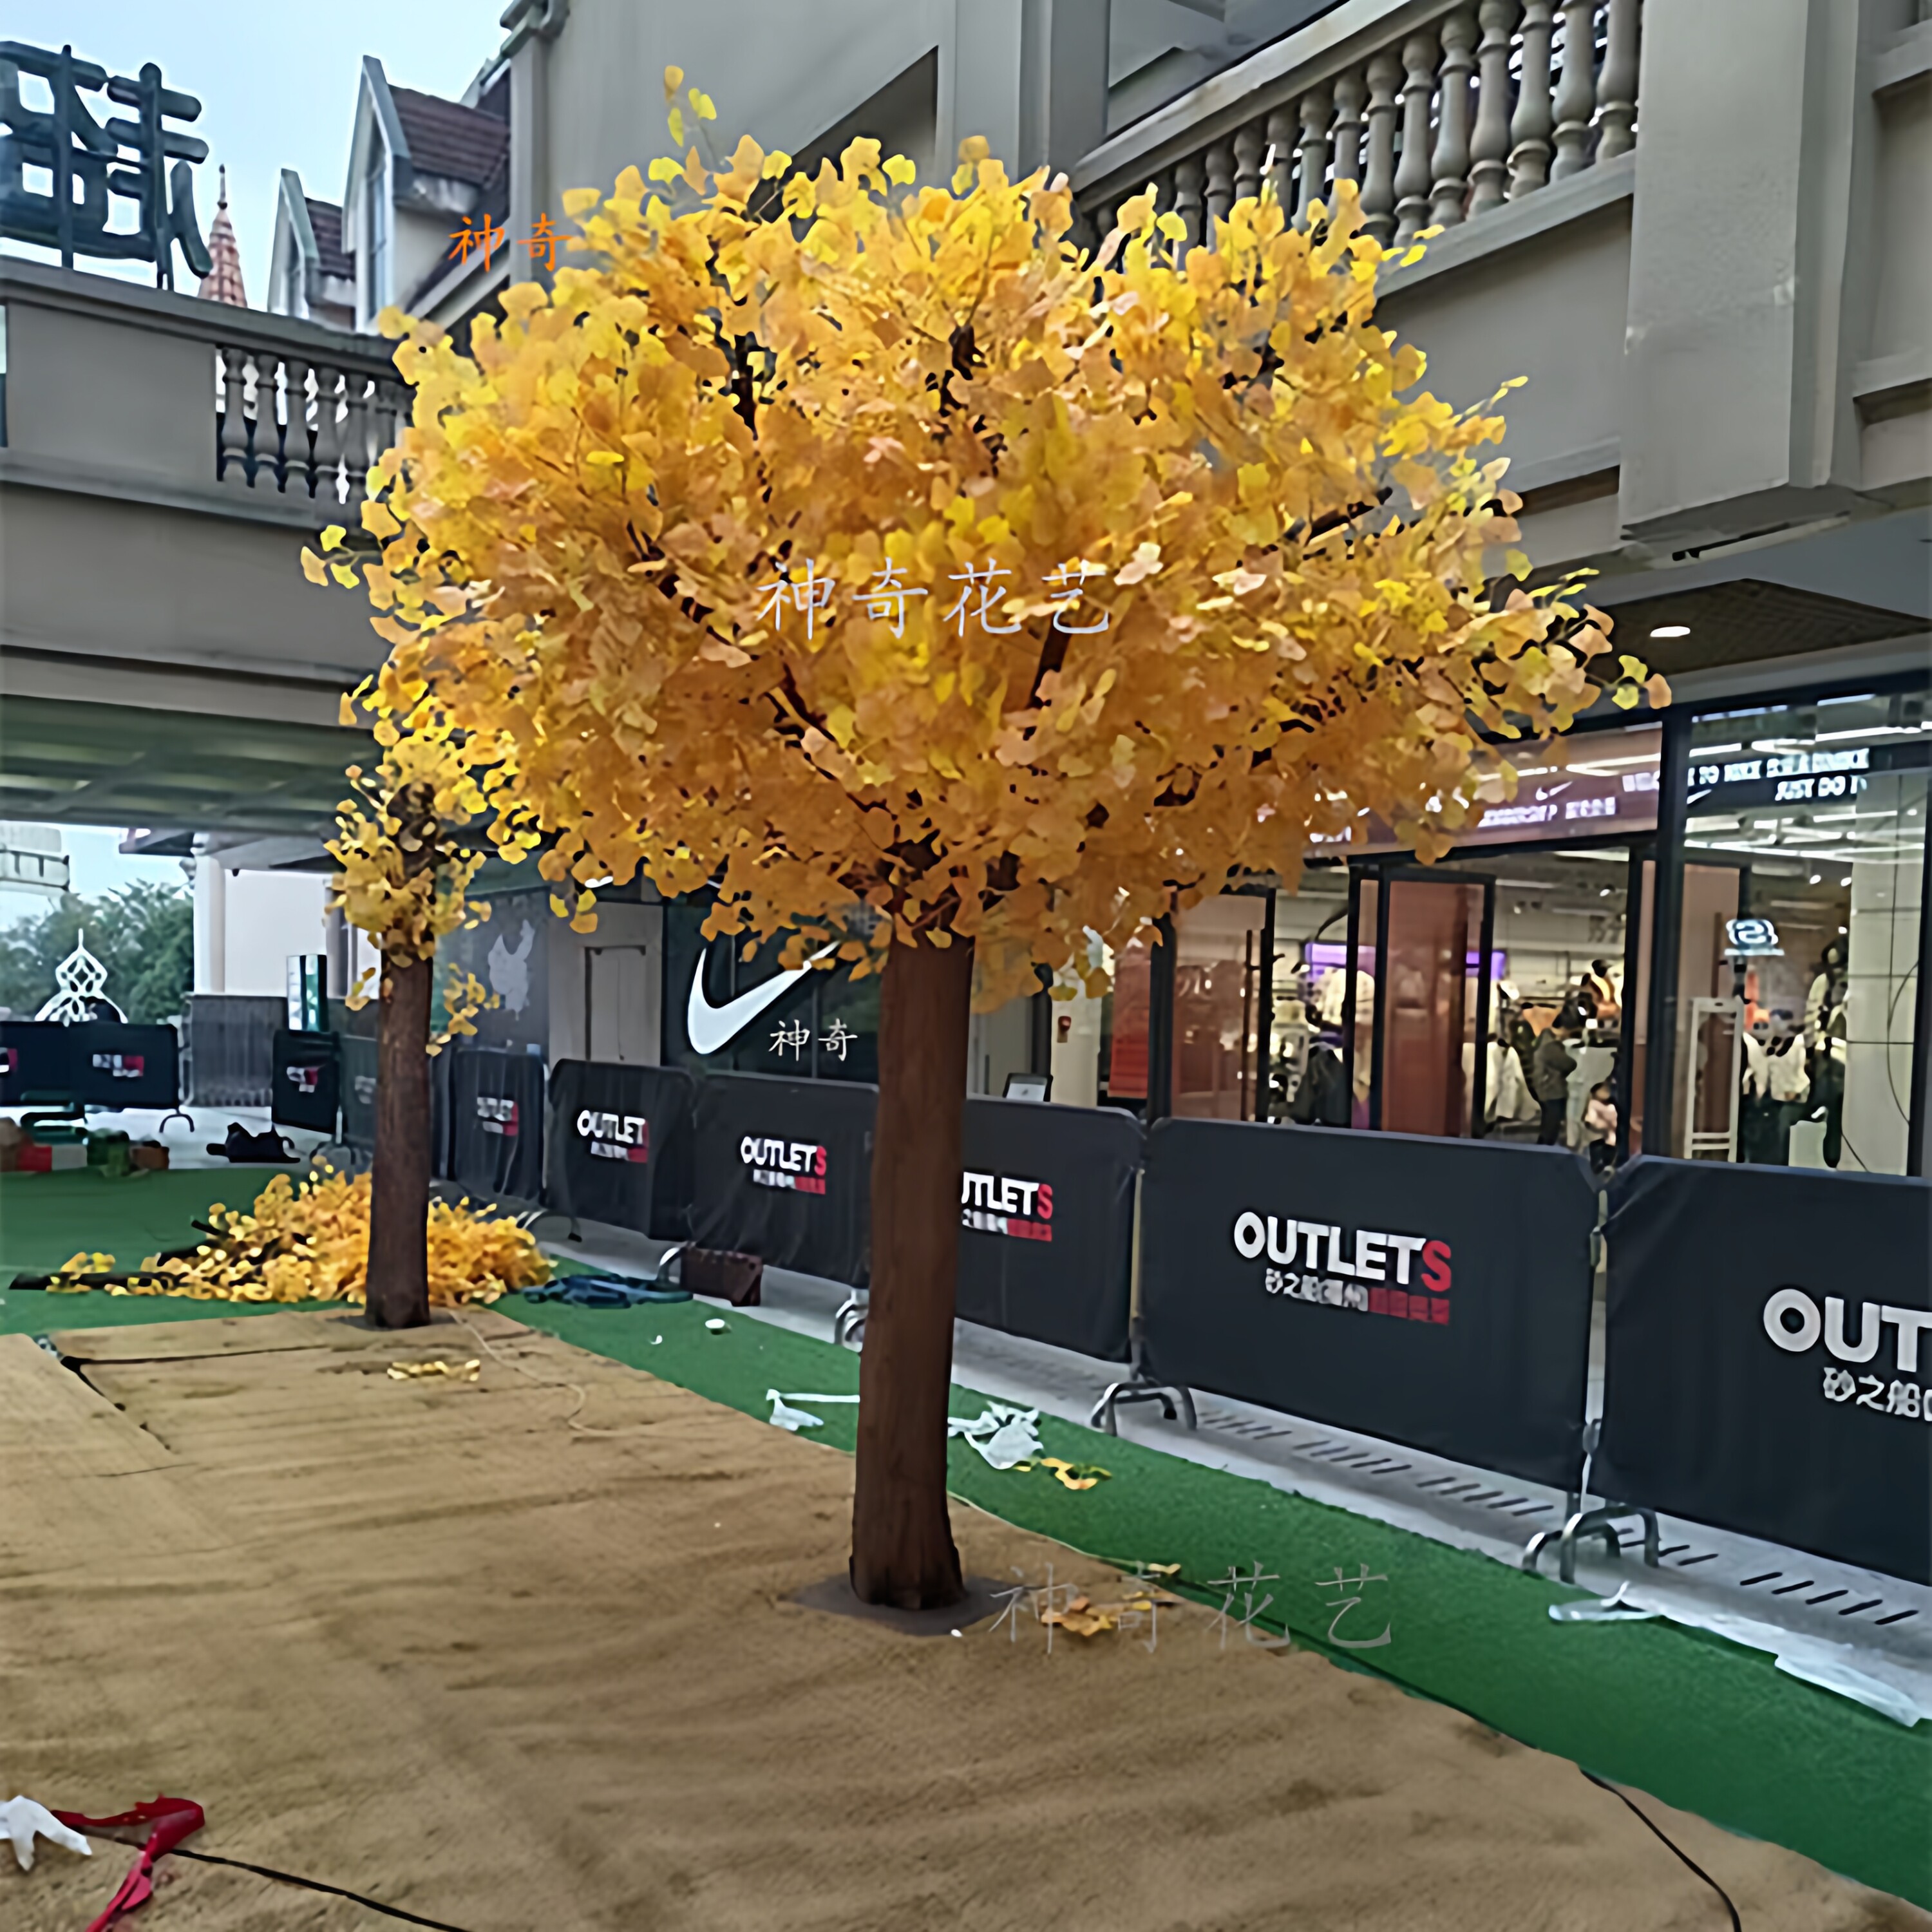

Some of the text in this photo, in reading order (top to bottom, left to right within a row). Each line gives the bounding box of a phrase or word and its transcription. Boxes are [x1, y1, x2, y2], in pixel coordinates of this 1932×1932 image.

[741, 1136, 827, 1176] OUTLETS
[1234, 1211, 1452, 1292] OUTLETS
[1763, 1289, 1932, 1372] OUT
